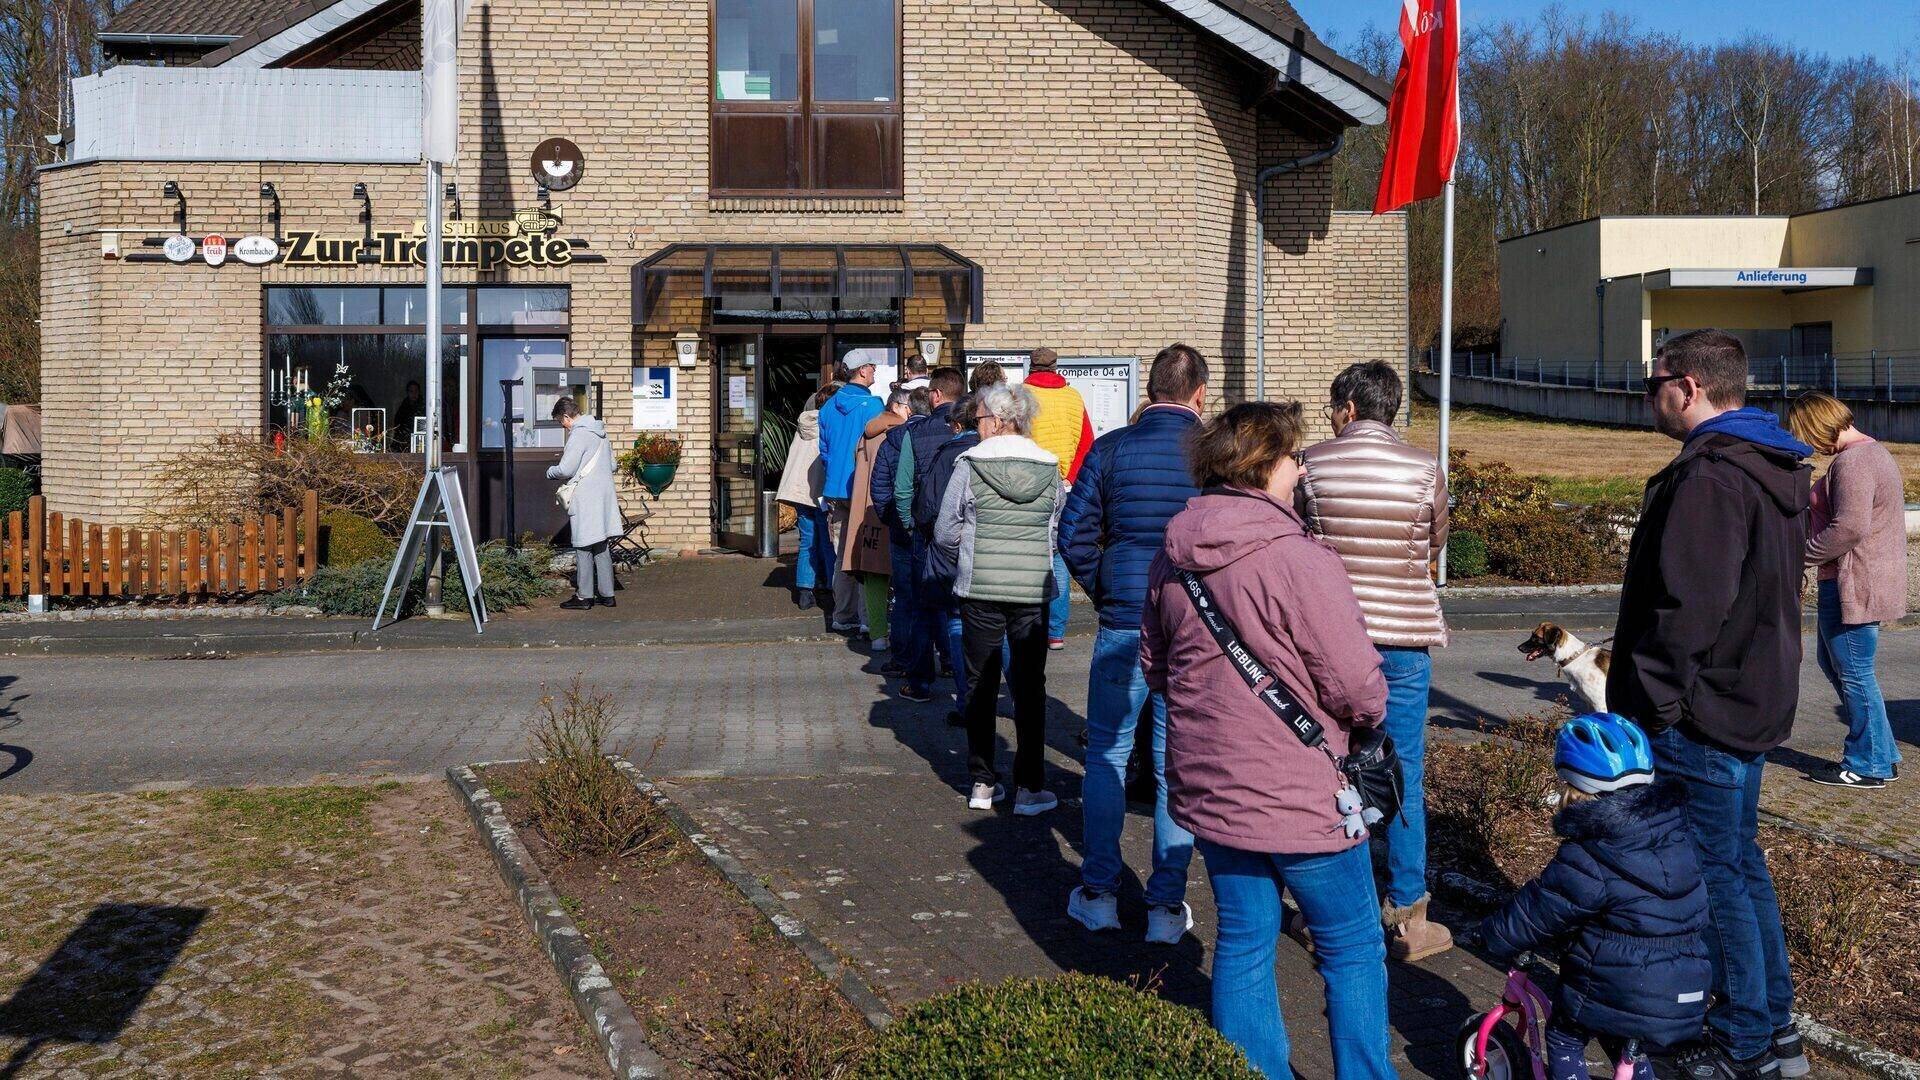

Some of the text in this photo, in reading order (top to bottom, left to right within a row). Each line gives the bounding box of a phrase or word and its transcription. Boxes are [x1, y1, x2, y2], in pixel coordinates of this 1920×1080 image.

[422, 222, 510, 234] GSTHAUS
[239, 247, 275, 256] Krombacher
[285, 230, 359, 264] Zur
[1737, 270, 1807, 284] Anlieferung
[1057, 367, 1099, 378] rompete
[1102, 367, 1115, 377] 04
